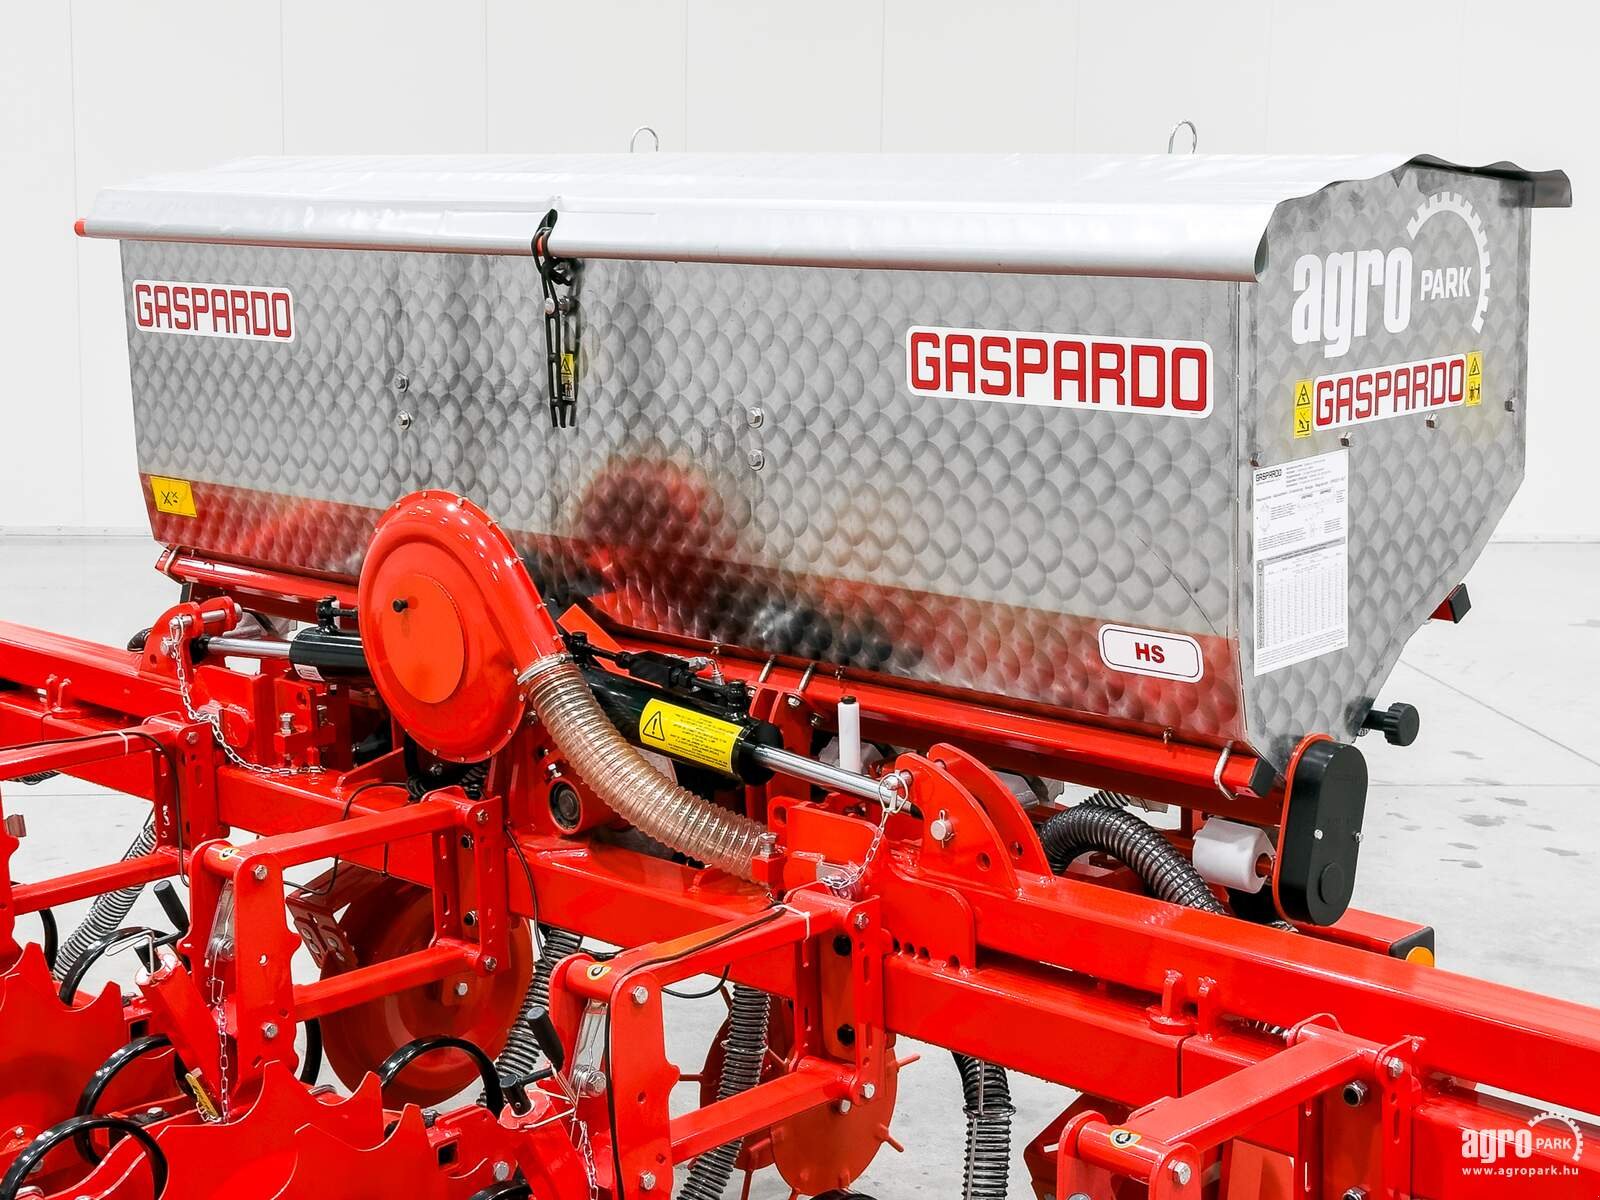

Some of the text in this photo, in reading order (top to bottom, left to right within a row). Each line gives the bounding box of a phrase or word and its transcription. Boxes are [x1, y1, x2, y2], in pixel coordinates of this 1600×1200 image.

[135, 284, 292, 337] GASPARDO
[1291, 246, 1472, 358] agro PARK
[910, 332, 1207, 412] GASPARDO
[1316, 358, 1465, 427] GASPARDO
[1135, 642, 1165, 664] HS
